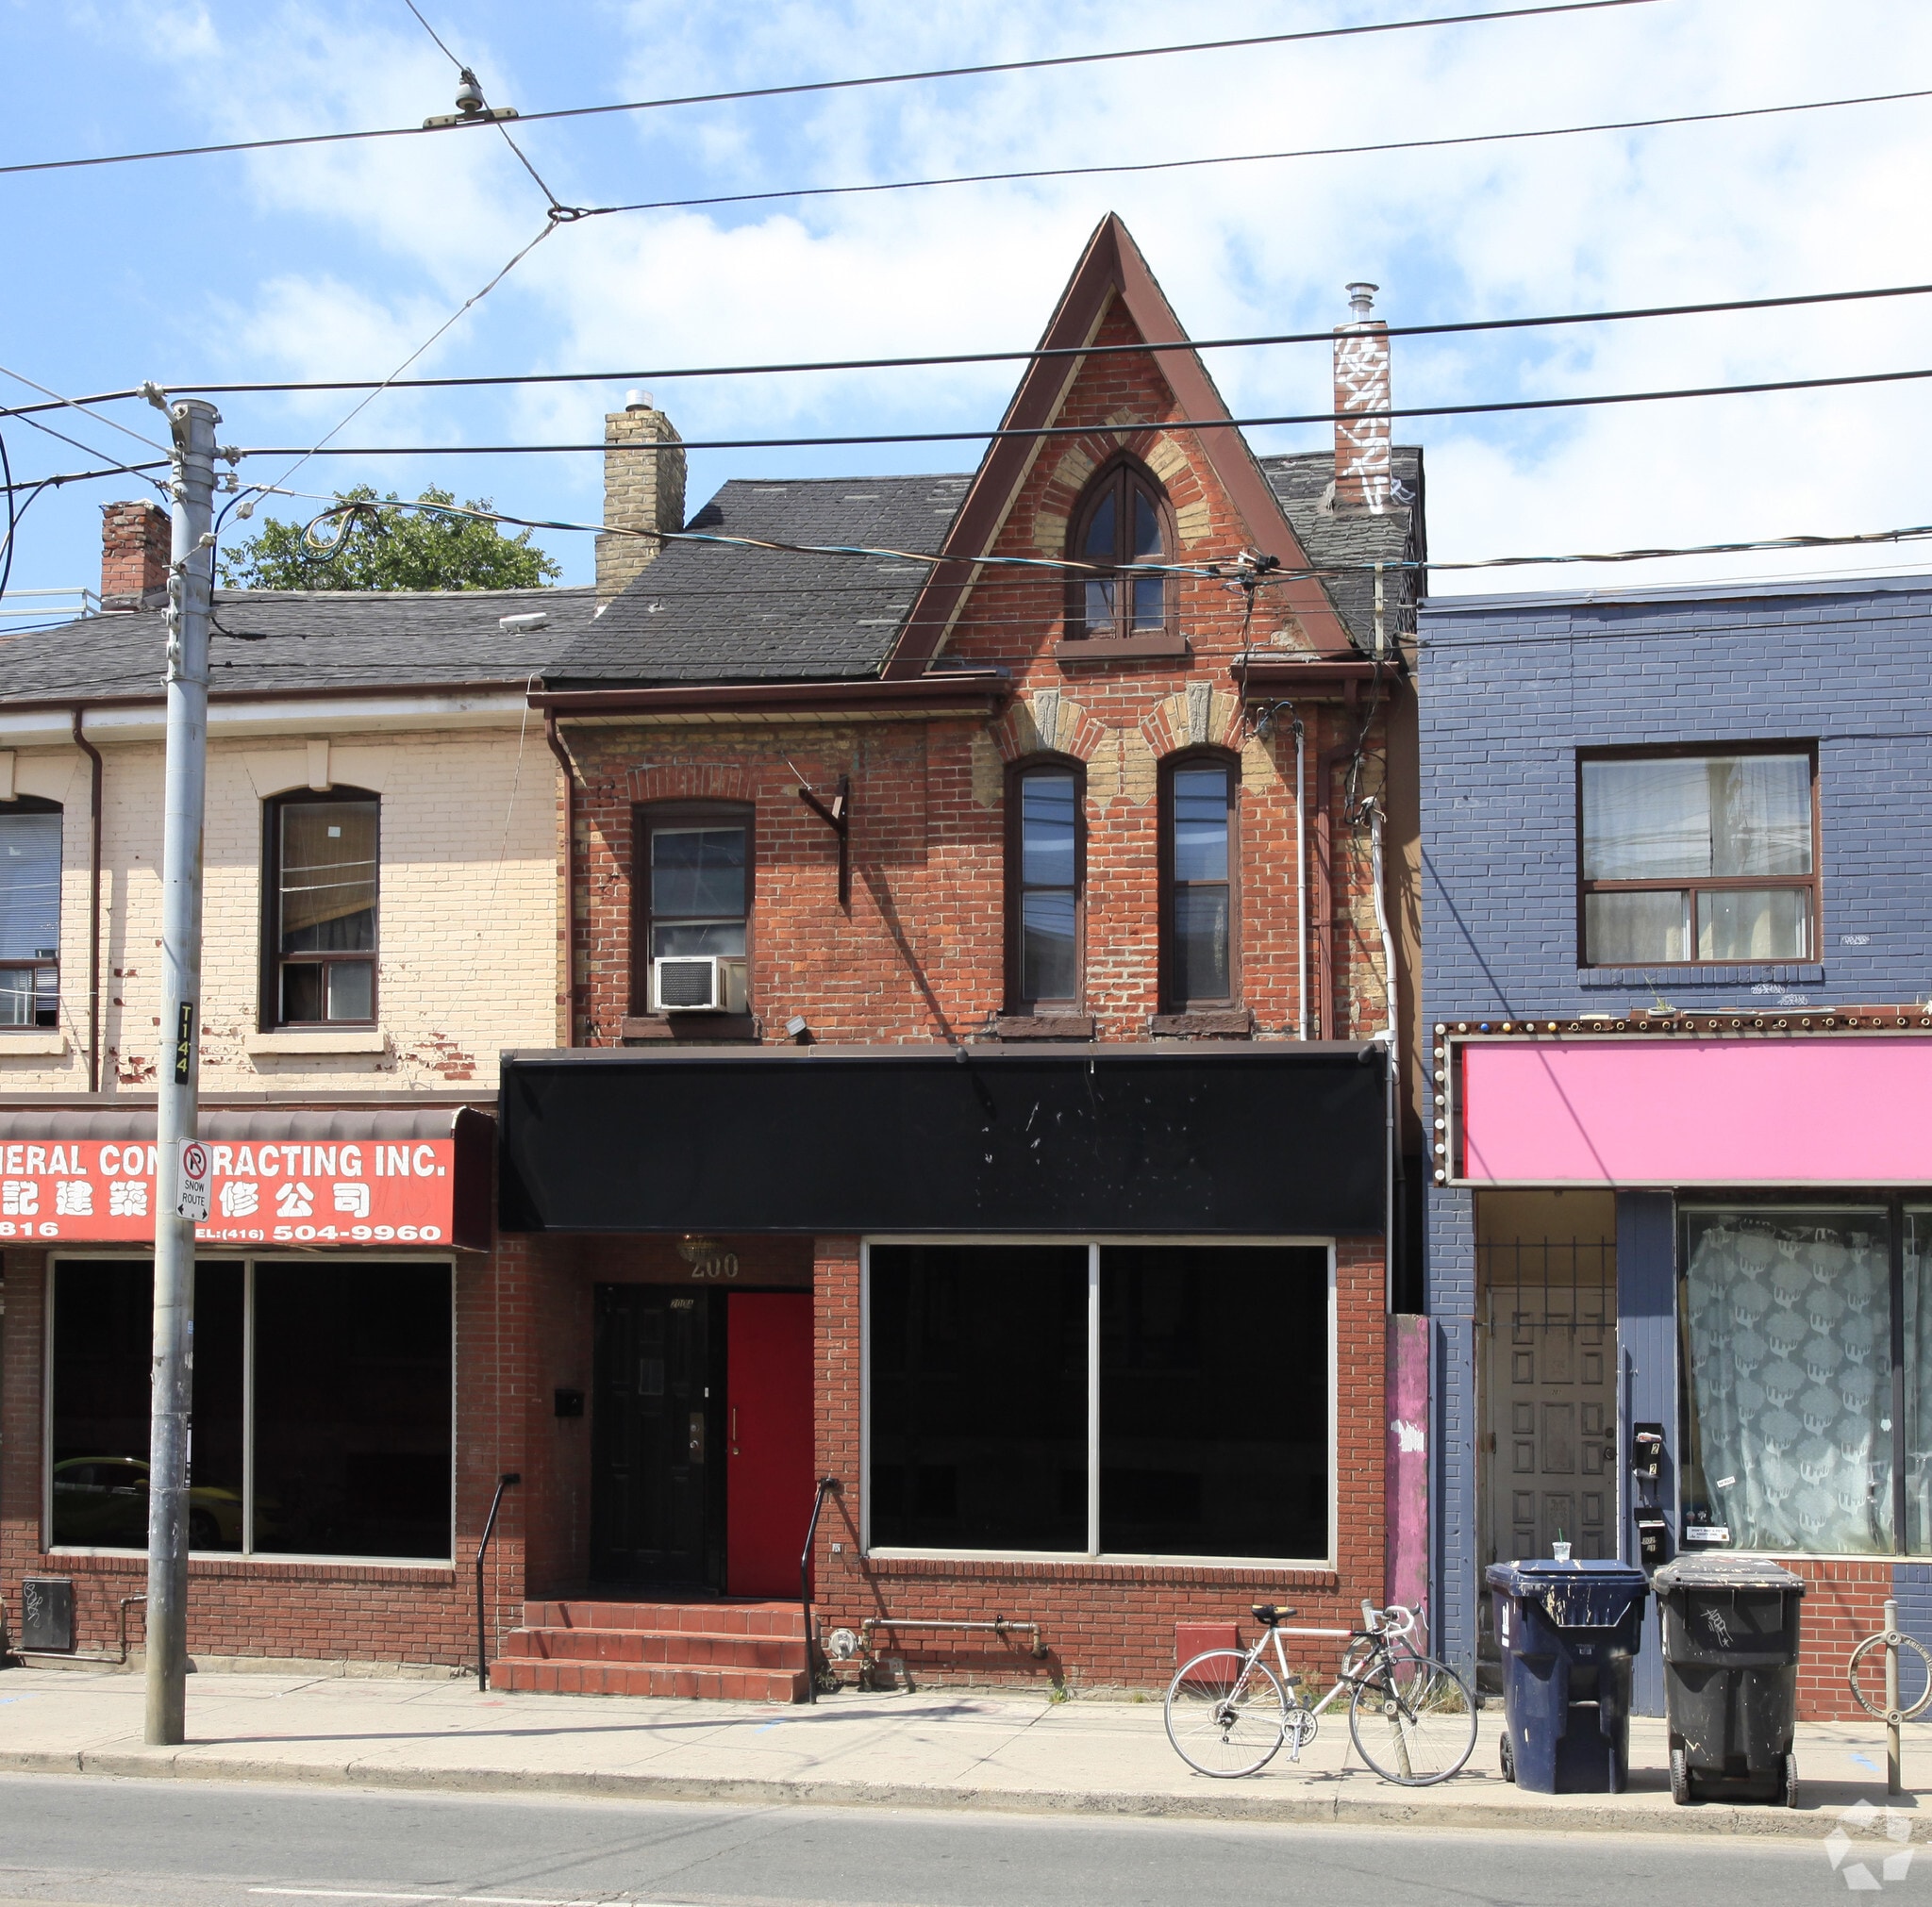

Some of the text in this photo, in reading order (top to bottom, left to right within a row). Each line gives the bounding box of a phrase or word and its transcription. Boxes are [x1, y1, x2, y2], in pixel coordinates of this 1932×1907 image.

[0, 1145, 445, 1177] ERAL CONRACTING INC.
[184, 1179, 205, 1192] SNOW
[182, 1192, 206, 1207] ROUTE
[194, 1225, 441, 1241] EL:(416) 504-9960
